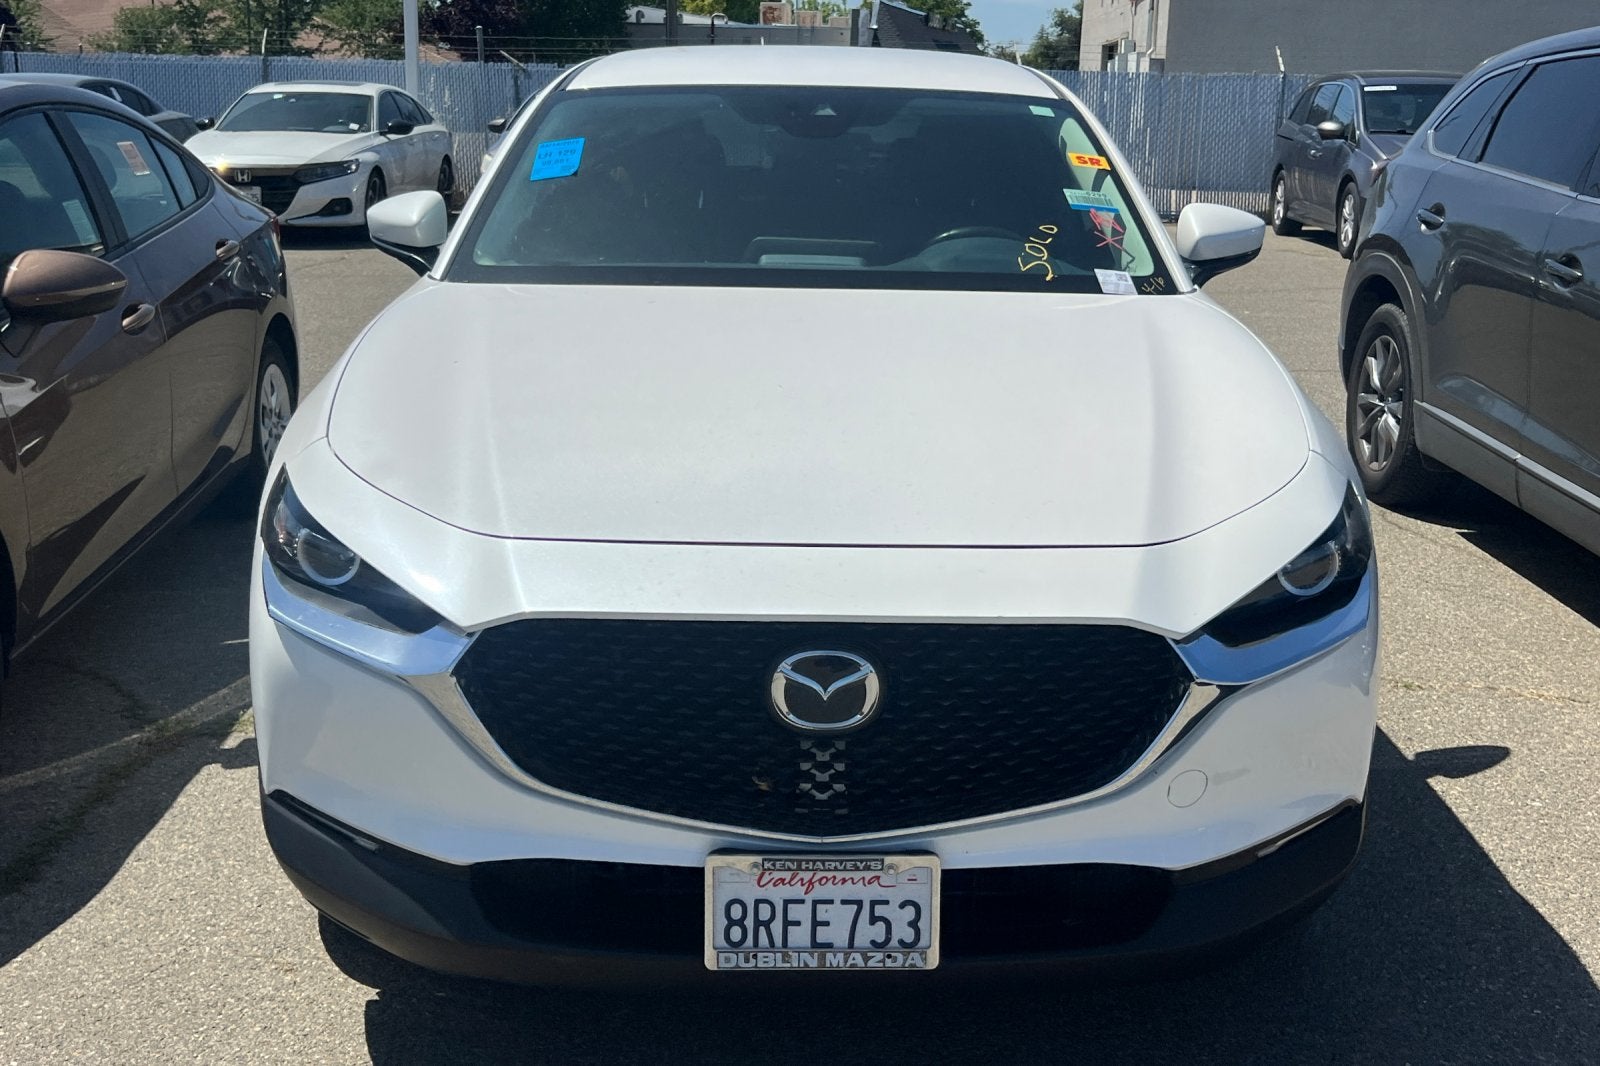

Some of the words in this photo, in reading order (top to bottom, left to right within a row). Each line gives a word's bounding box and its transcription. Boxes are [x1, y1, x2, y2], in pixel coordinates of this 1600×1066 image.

[1075, 155, 1104, 167] SR
[763, 860, 798, 871] KEN
[801, 860, 883, 871] HARVEY'S
[757, 871, 896, 895] California
[723, 898, 923, 950] 8RFE753
[718, 952, 818, 968] DUBLIN
[825, 952, 925, 968] MAZDA
